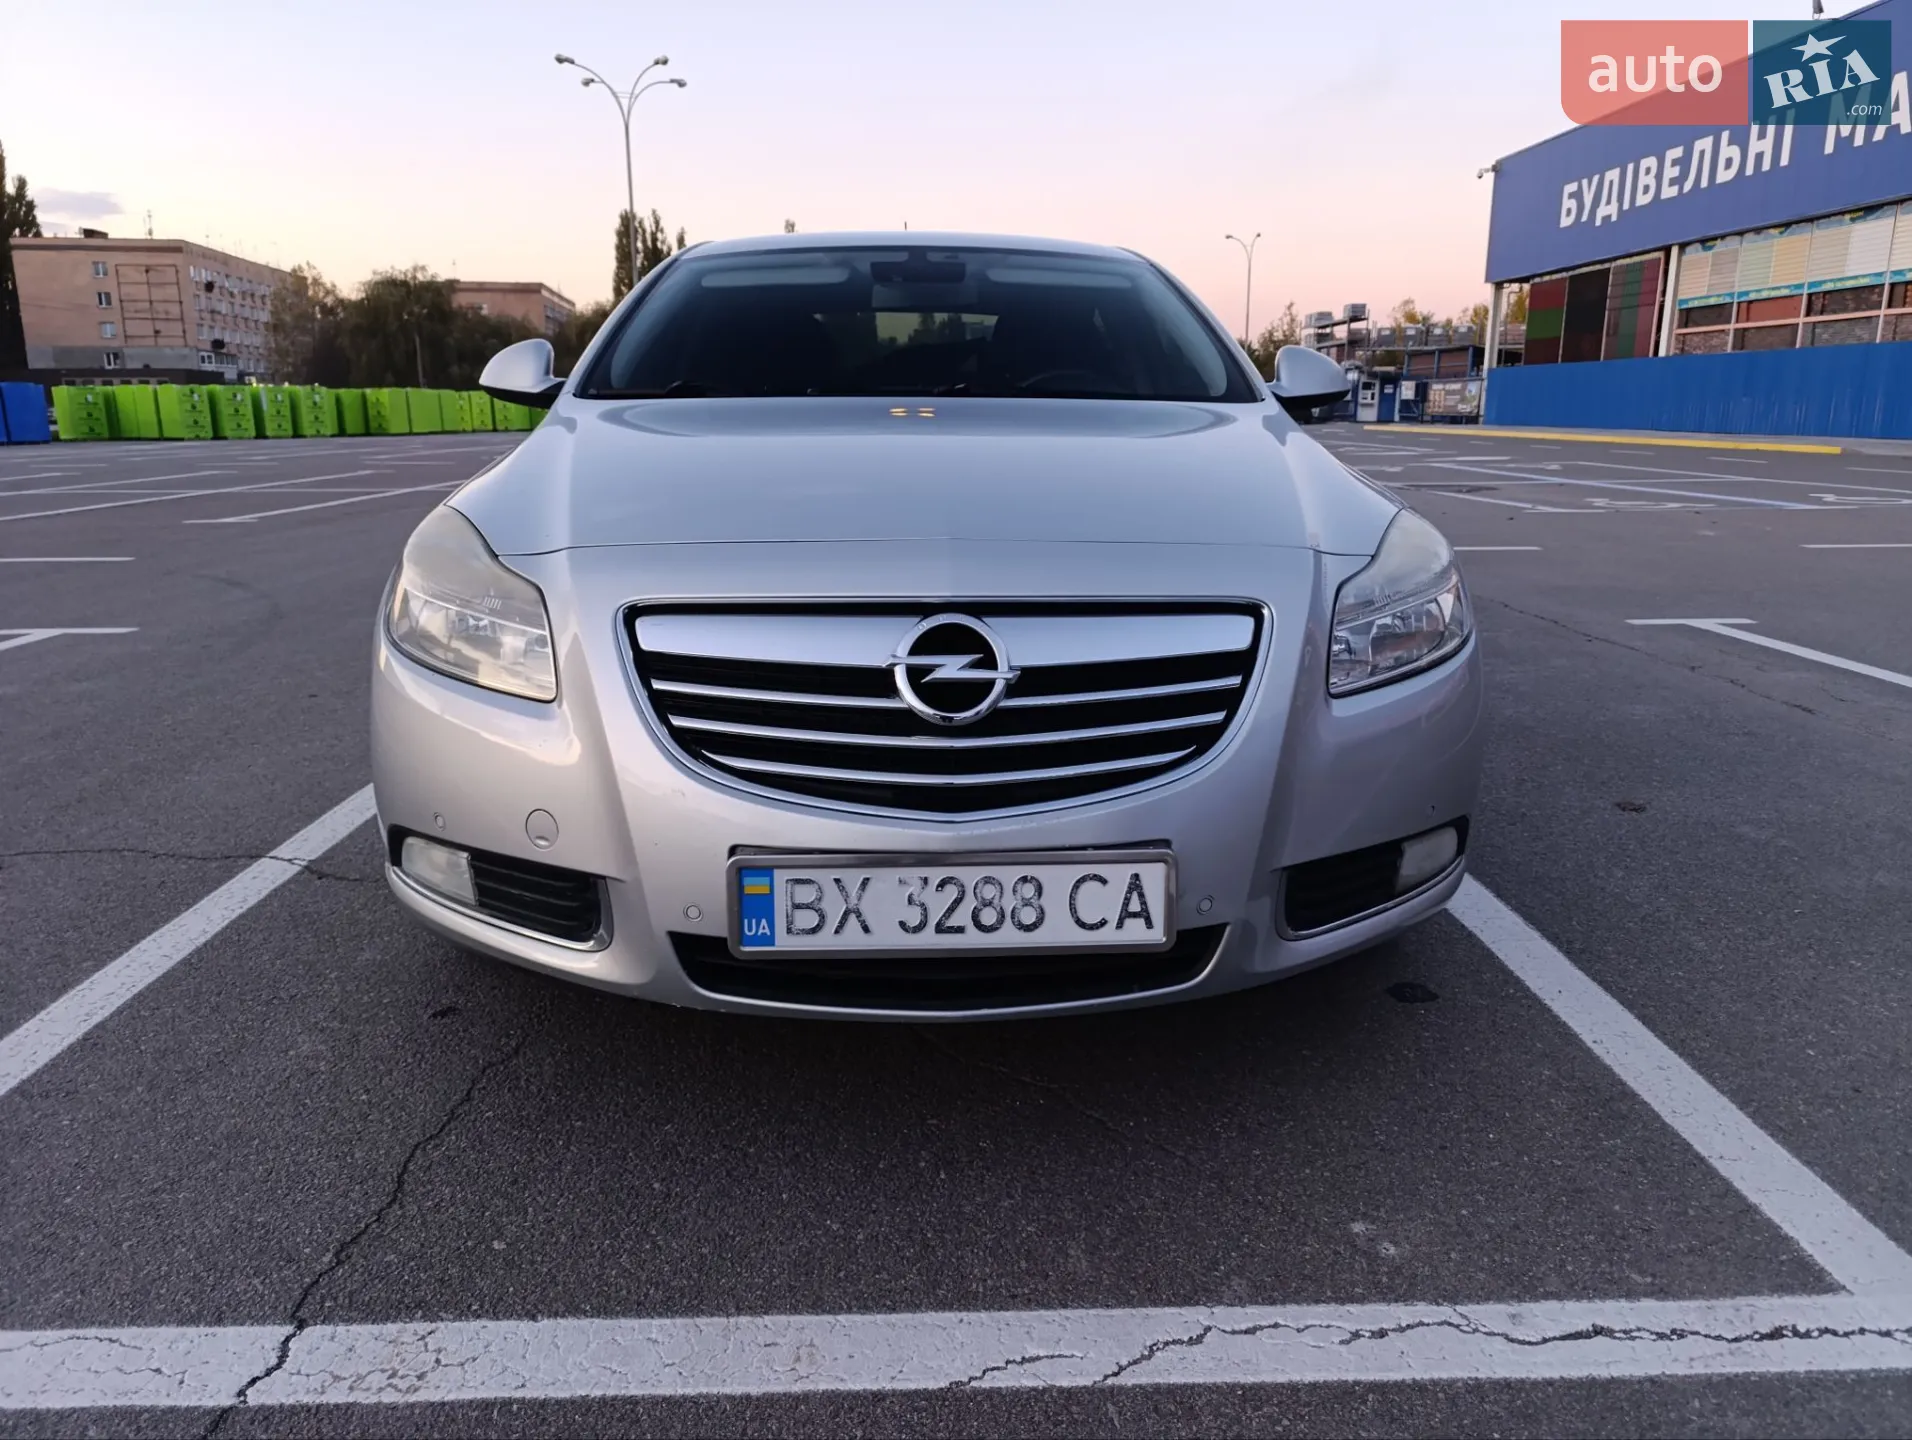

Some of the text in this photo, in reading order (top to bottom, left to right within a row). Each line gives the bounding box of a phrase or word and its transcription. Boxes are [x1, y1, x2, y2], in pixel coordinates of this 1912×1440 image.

[1559, 107, 1796, 228] БУДІВЕЛЬНІ
[743, 918, 771, 936] UA
[784, 872, 1154, 936] BX 3288 CA
